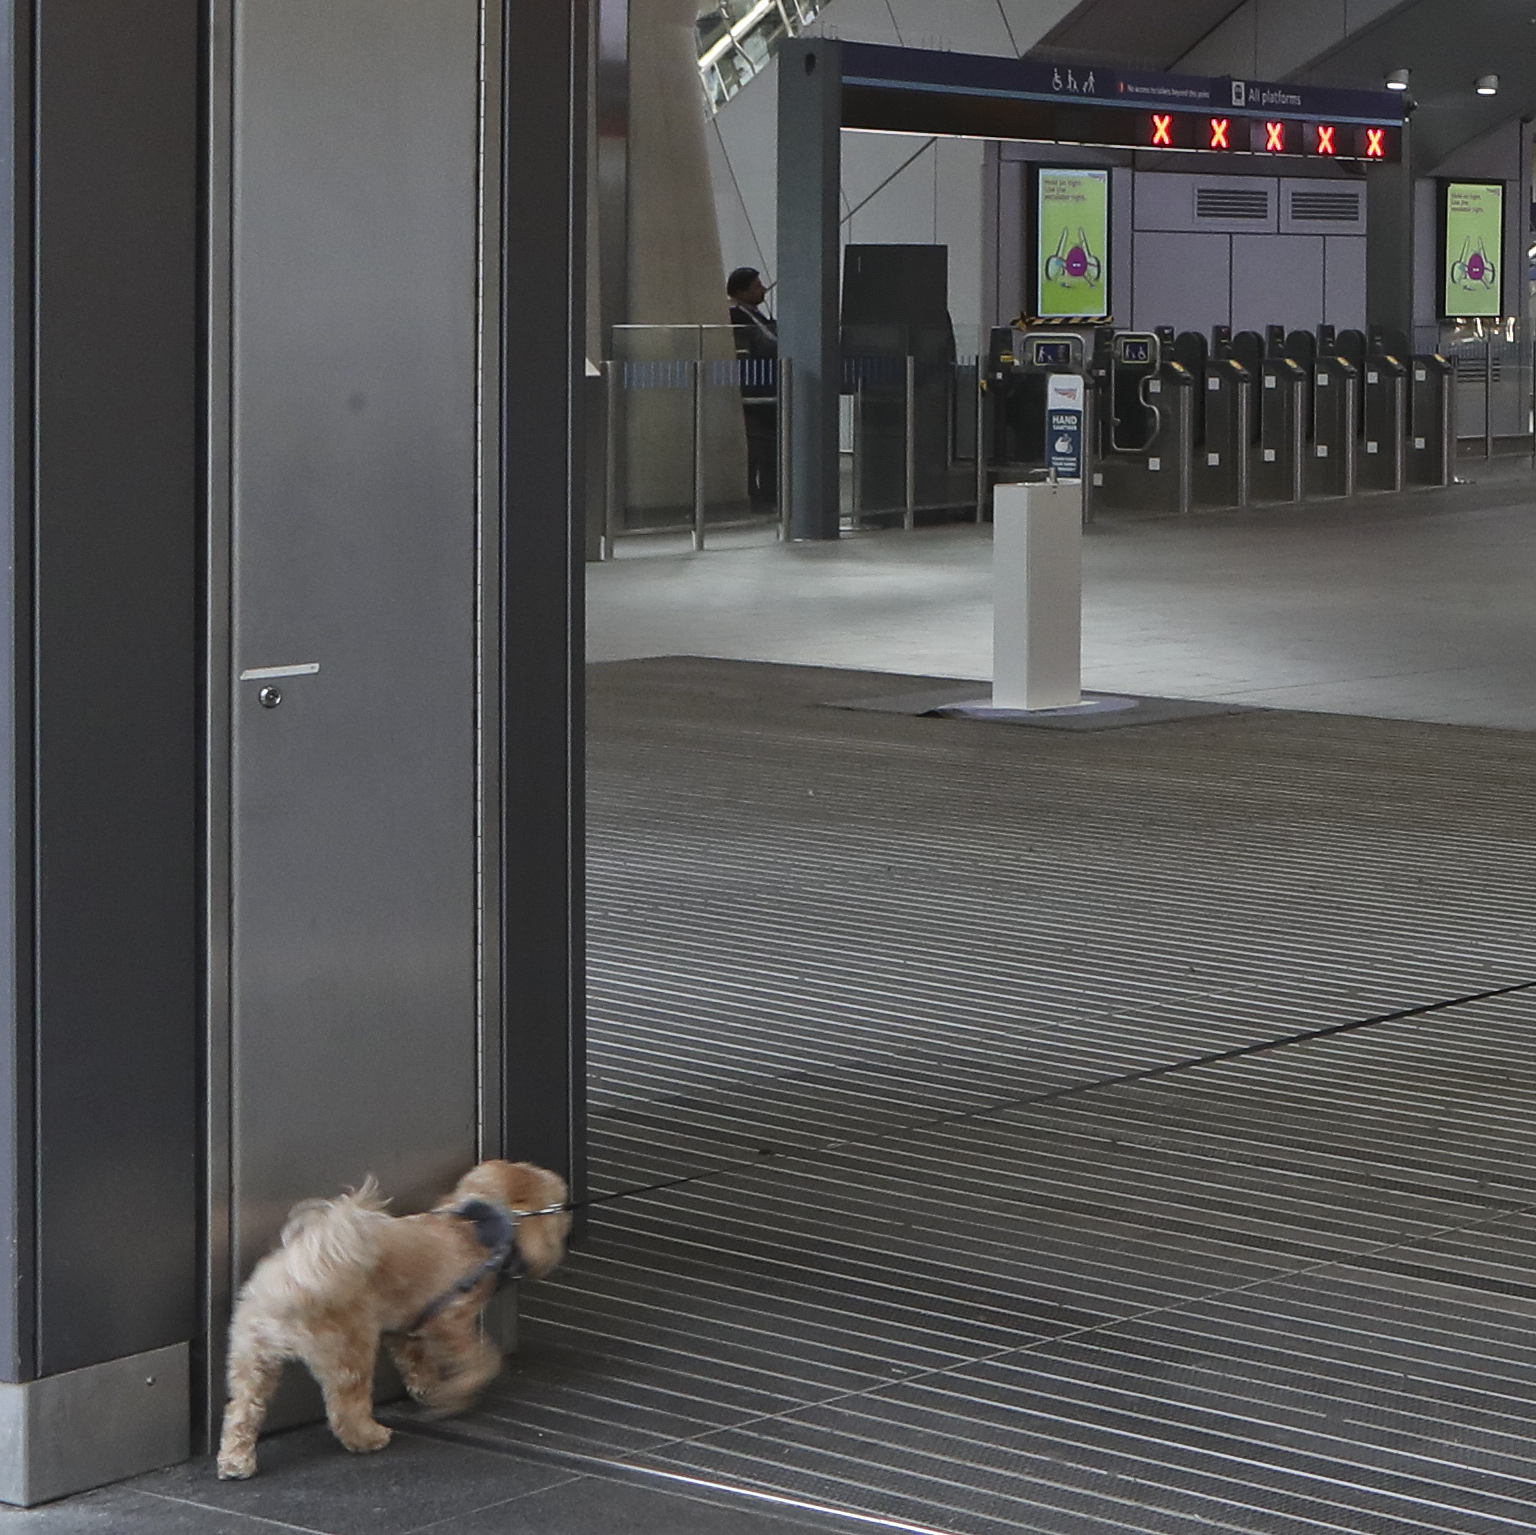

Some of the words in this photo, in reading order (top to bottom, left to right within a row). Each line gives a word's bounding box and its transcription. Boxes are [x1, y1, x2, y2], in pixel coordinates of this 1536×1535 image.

[1248, 88, 1260, 103] All
[1262, 90, 1302, 106] platforms
[1052, 415, 1078, 425] HAND
